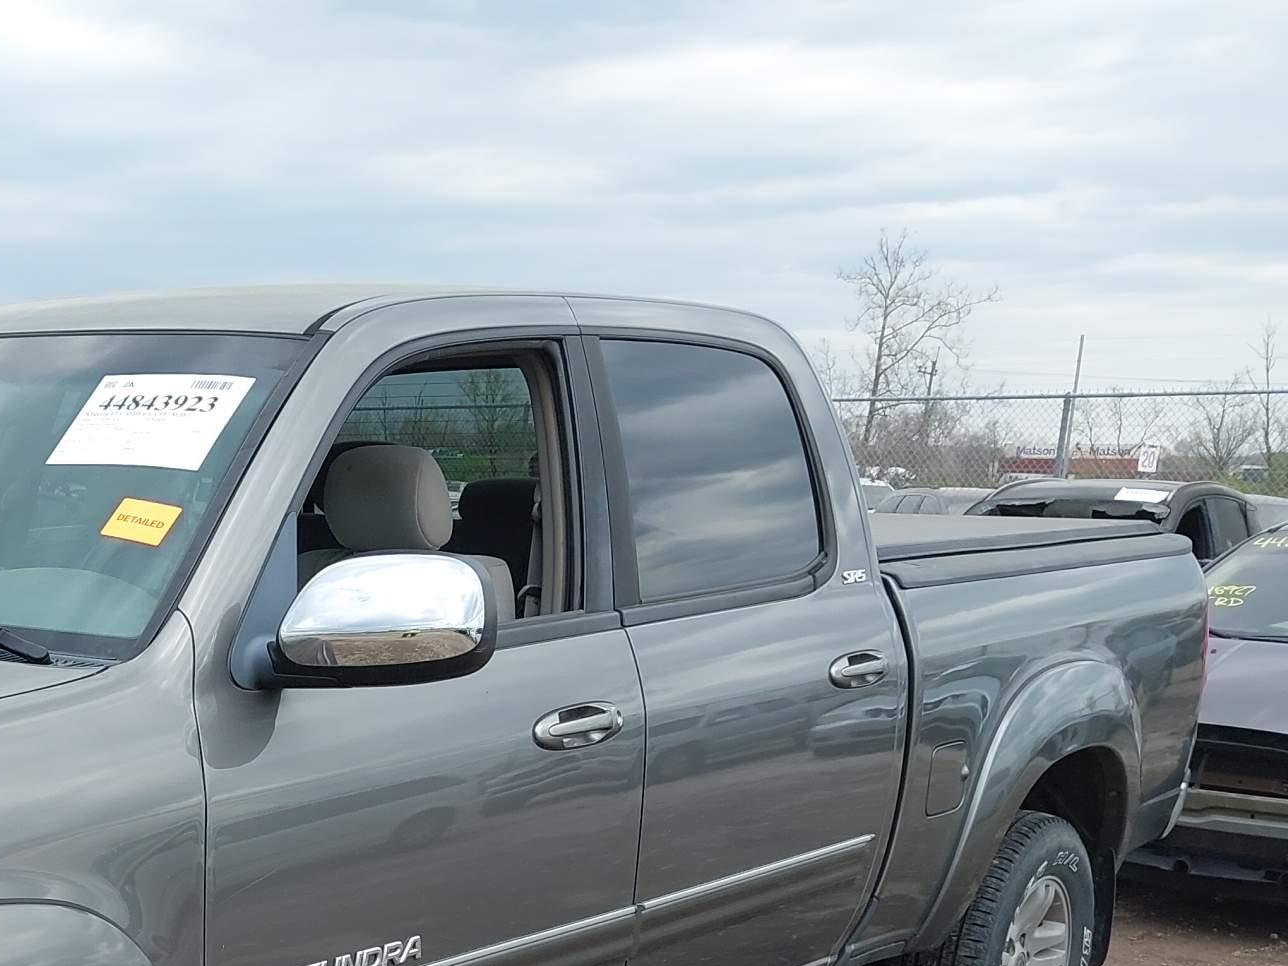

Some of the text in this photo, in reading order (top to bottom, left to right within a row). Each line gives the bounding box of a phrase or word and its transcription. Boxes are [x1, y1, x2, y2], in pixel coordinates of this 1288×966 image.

[98, 394, 219, 413] 44843923
[1016, 445, 1055, 456] Matson
[116, 513, 165, 529] DETAILED
[842, 568, 867, 585] SR5
